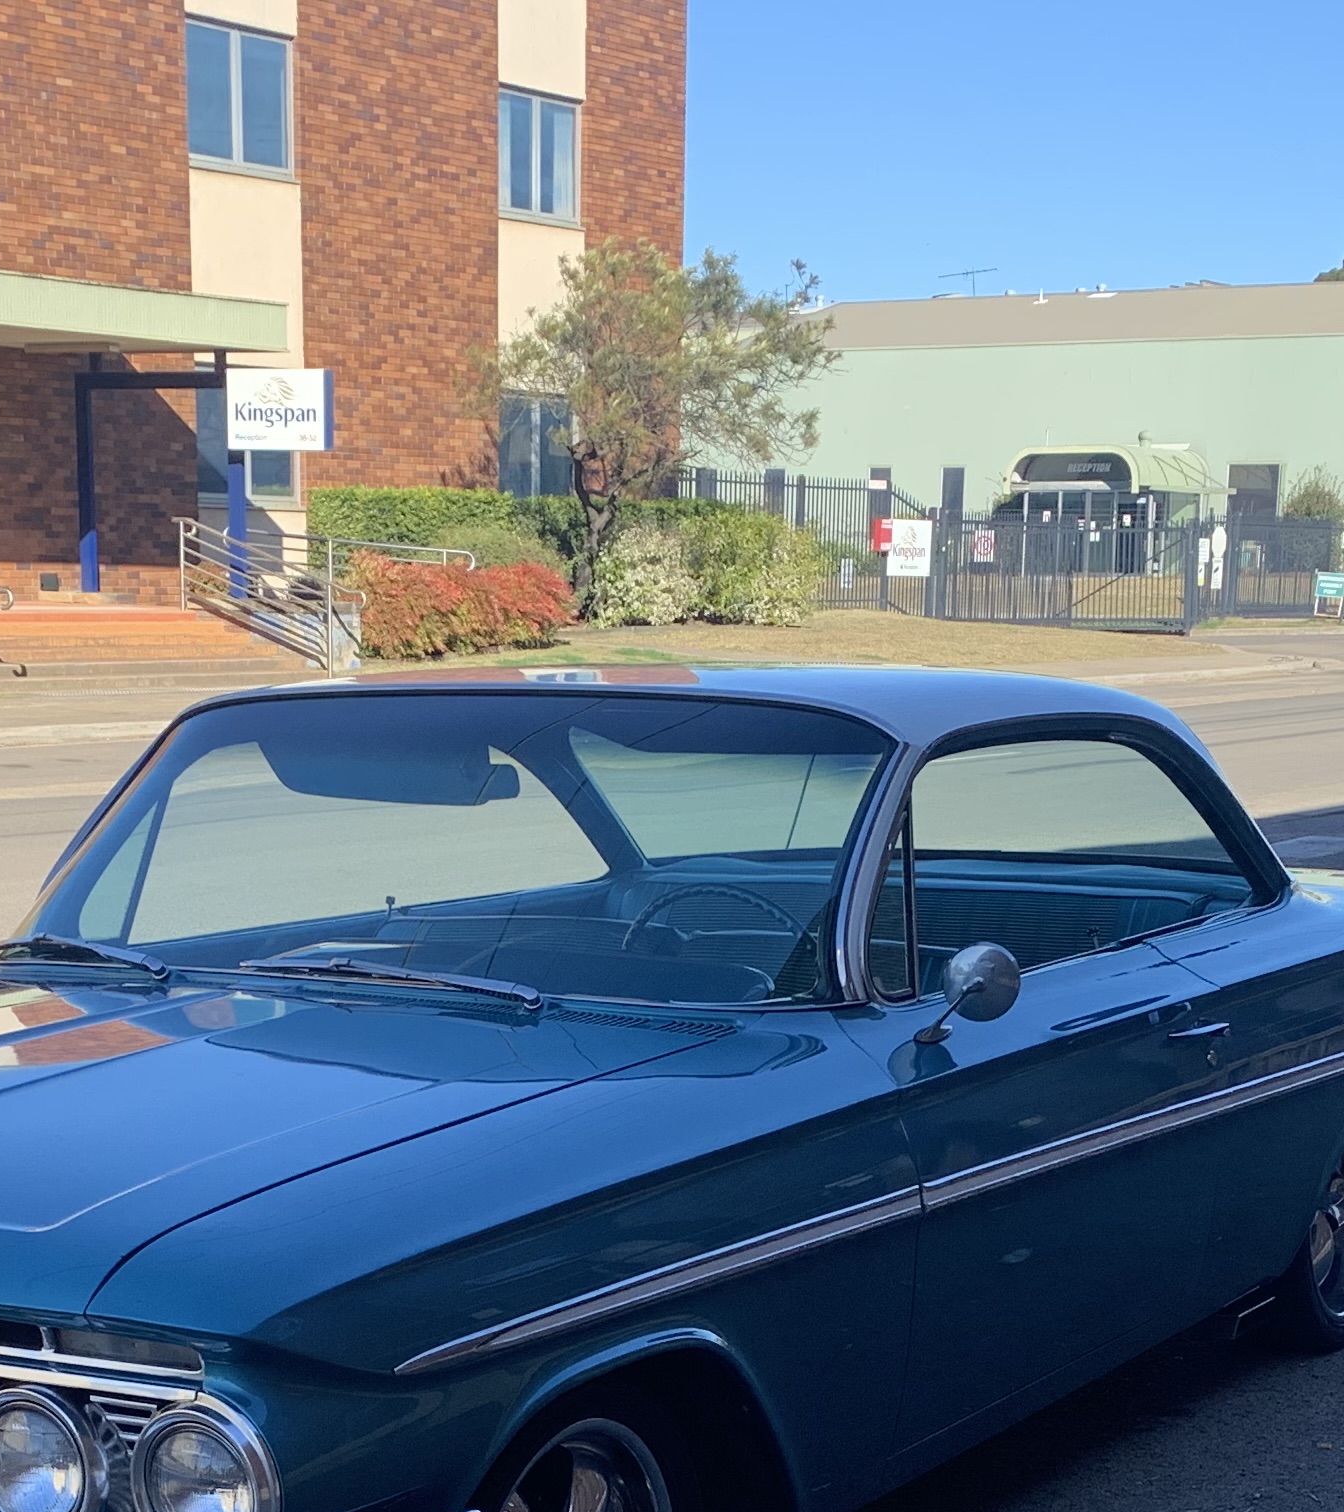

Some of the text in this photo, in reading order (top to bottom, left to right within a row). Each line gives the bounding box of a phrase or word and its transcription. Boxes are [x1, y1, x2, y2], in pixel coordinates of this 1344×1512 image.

[234, 401, 317, 428] Kingspan
[235, 434, 268, 442] Reception
[1067, 462, 1112, 473] RECEPTION
[892, 543, 926, 561] Kingspan
